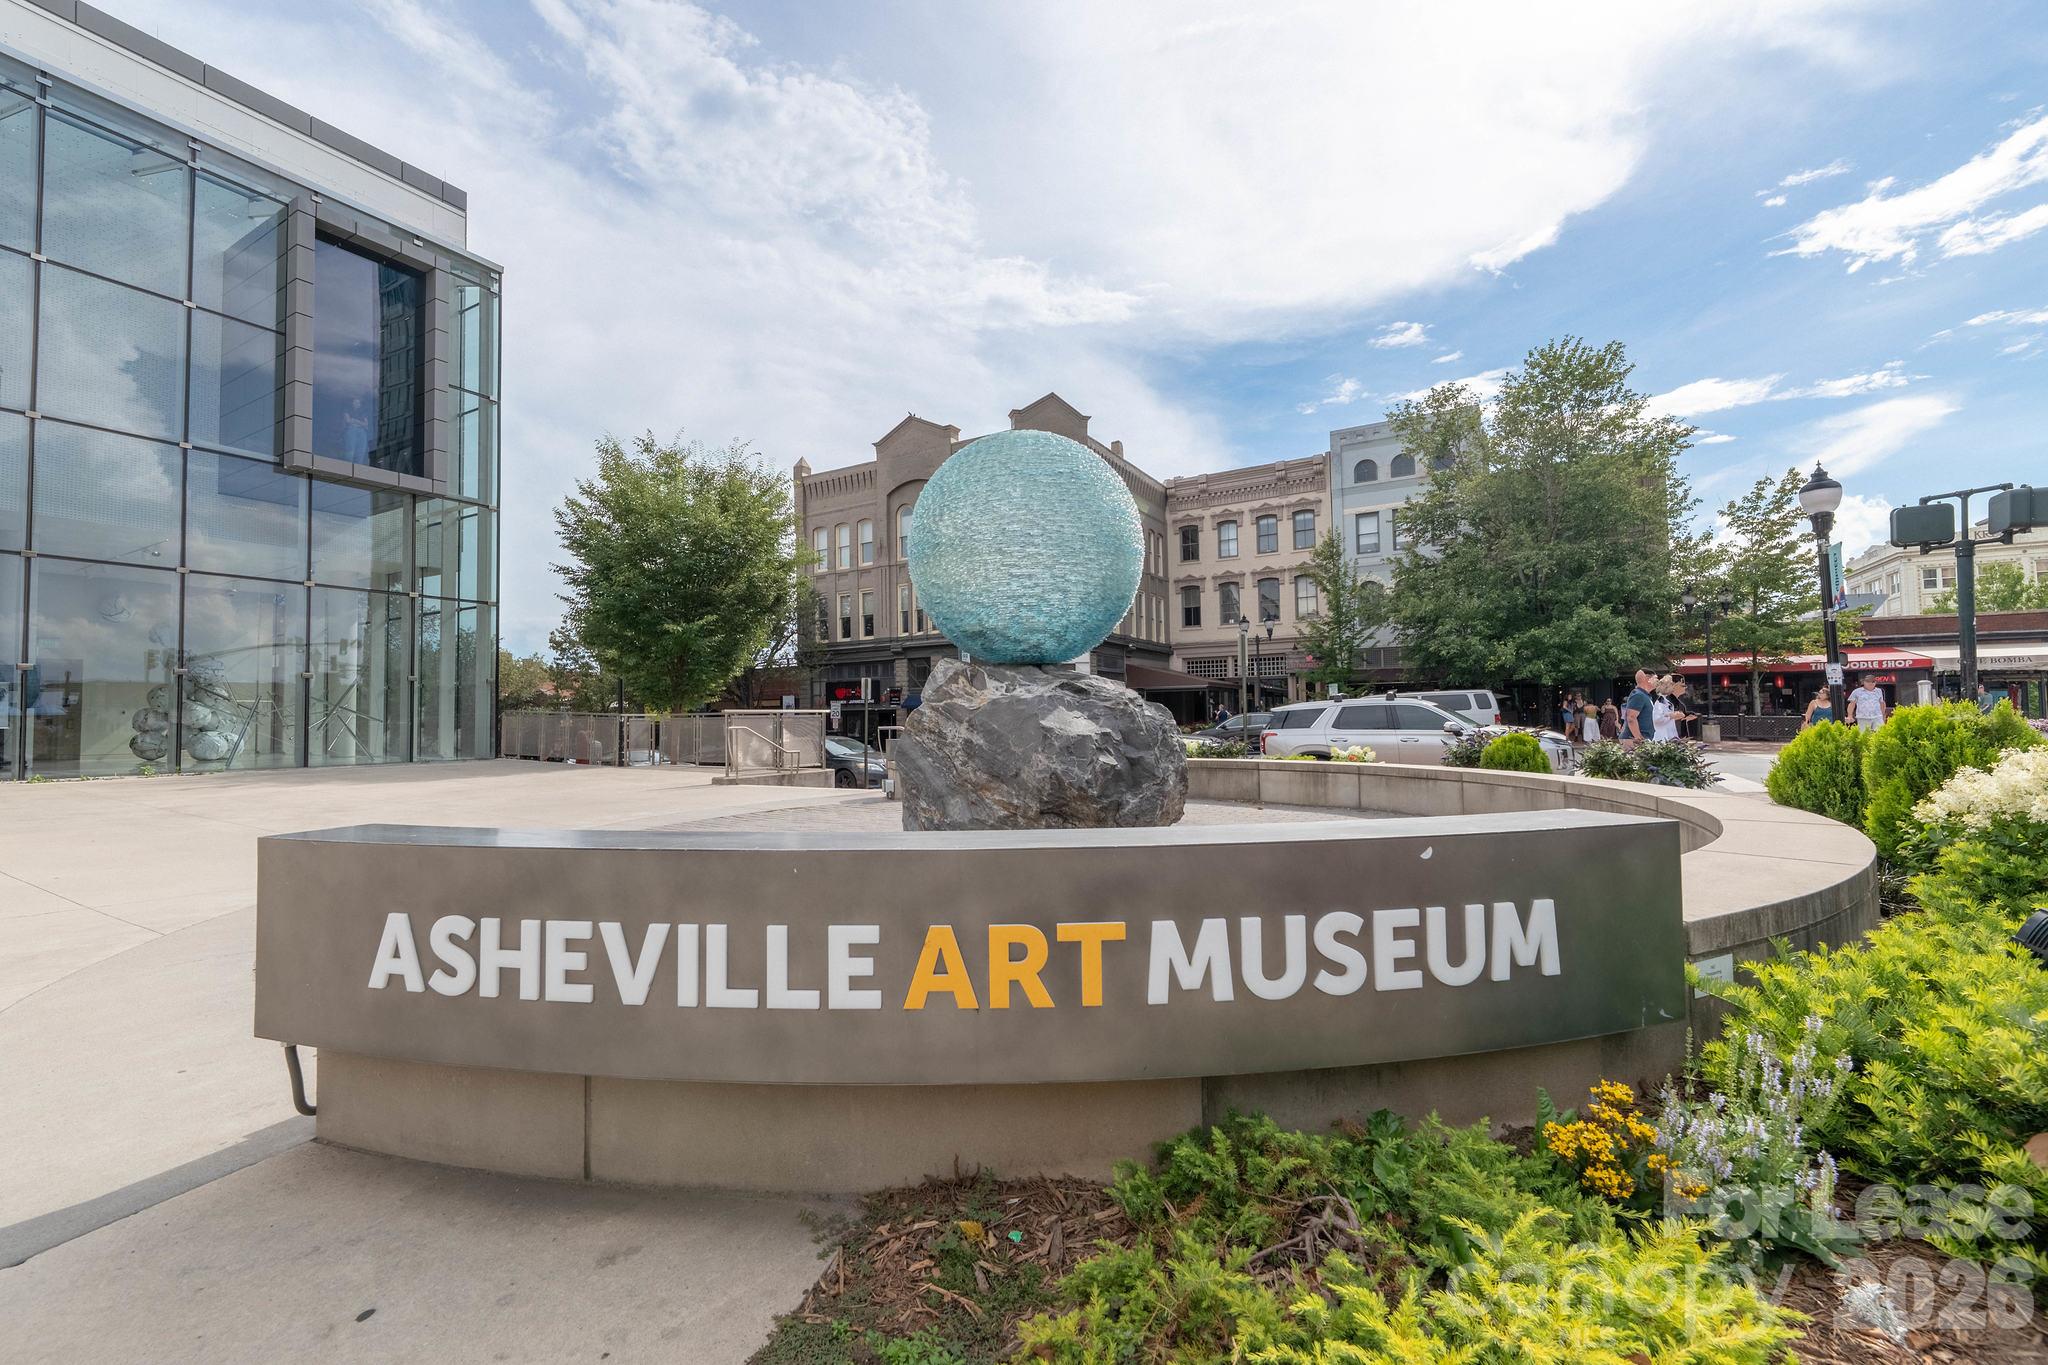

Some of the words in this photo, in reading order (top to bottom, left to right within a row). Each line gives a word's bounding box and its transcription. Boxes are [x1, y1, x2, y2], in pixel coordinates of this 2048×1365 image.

[1809, 662, 1828, 671] TH
[1841, 660, 1879, 670] ODLE
[1882, 659, 1913, 668] SHOP
[1990, 656, 2033, 664] BOMBA
[367, 912, 882, 1010] ASHEVILLE
[903, 921, 1127, 1010] ART
[1147, 898, 1561, 1005] MUSEUM
